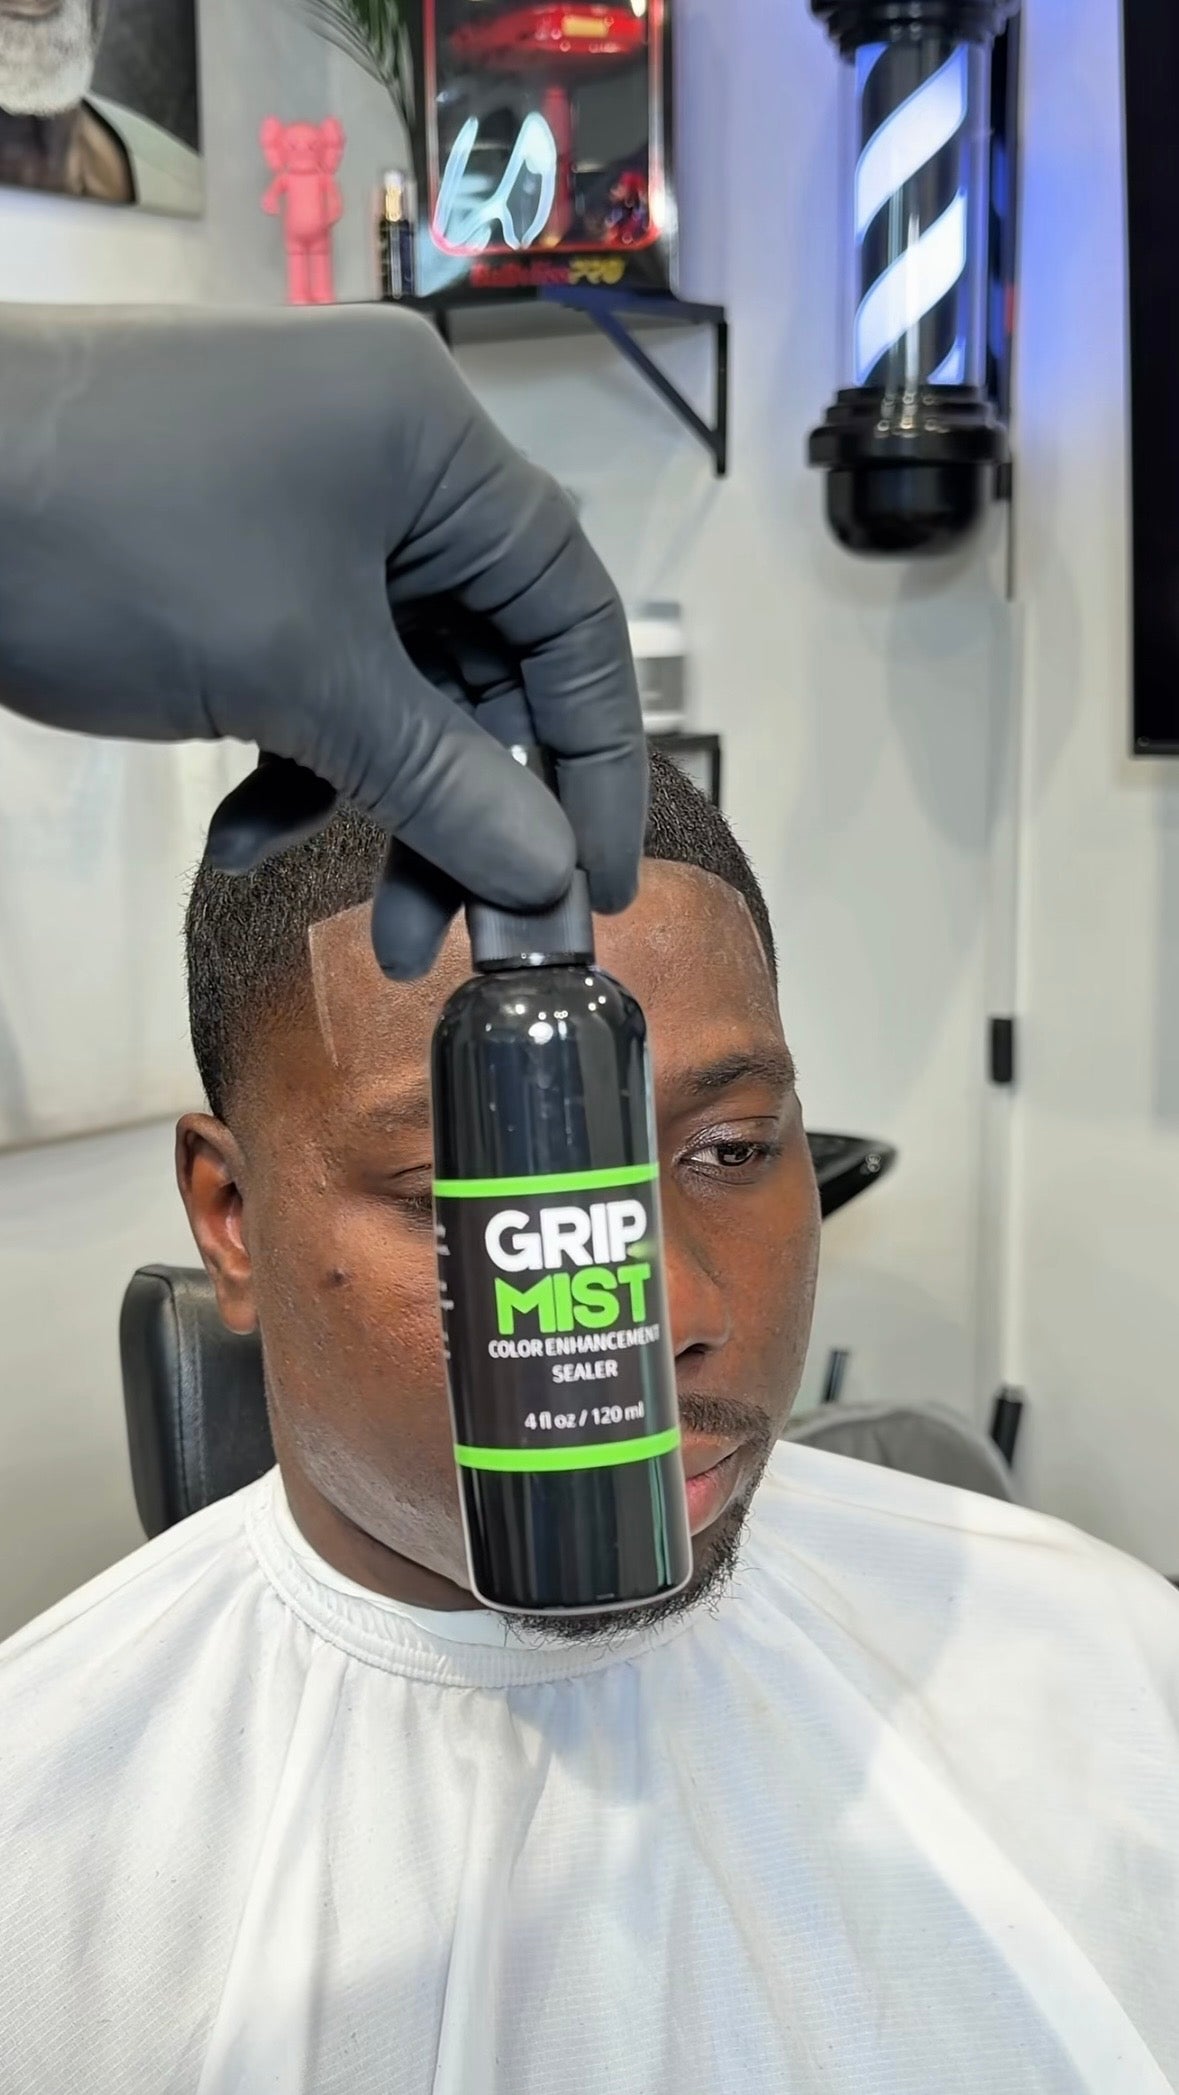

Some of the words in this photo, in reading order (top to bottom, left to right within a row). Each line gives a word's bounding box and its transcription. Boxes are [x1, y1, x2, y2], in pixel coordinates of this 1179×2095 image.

[486, 1199, 647, 1272] GRIP
[494, 1263, 651, 1335] MIST
[488, 1339, 544, 1359] COLOR
[545, 1324, 660, 1356] ENHANCEMENT
[552, 1359, 618, 1384] SEALER
[524, 1412, 538, 1430] 4
[539, 1411, 552, 1430] fl
[554, 1413, 577, 1430] oz
[591, 1405, 623, 1426] 120
[624, 1401, 645, 1421] ml
